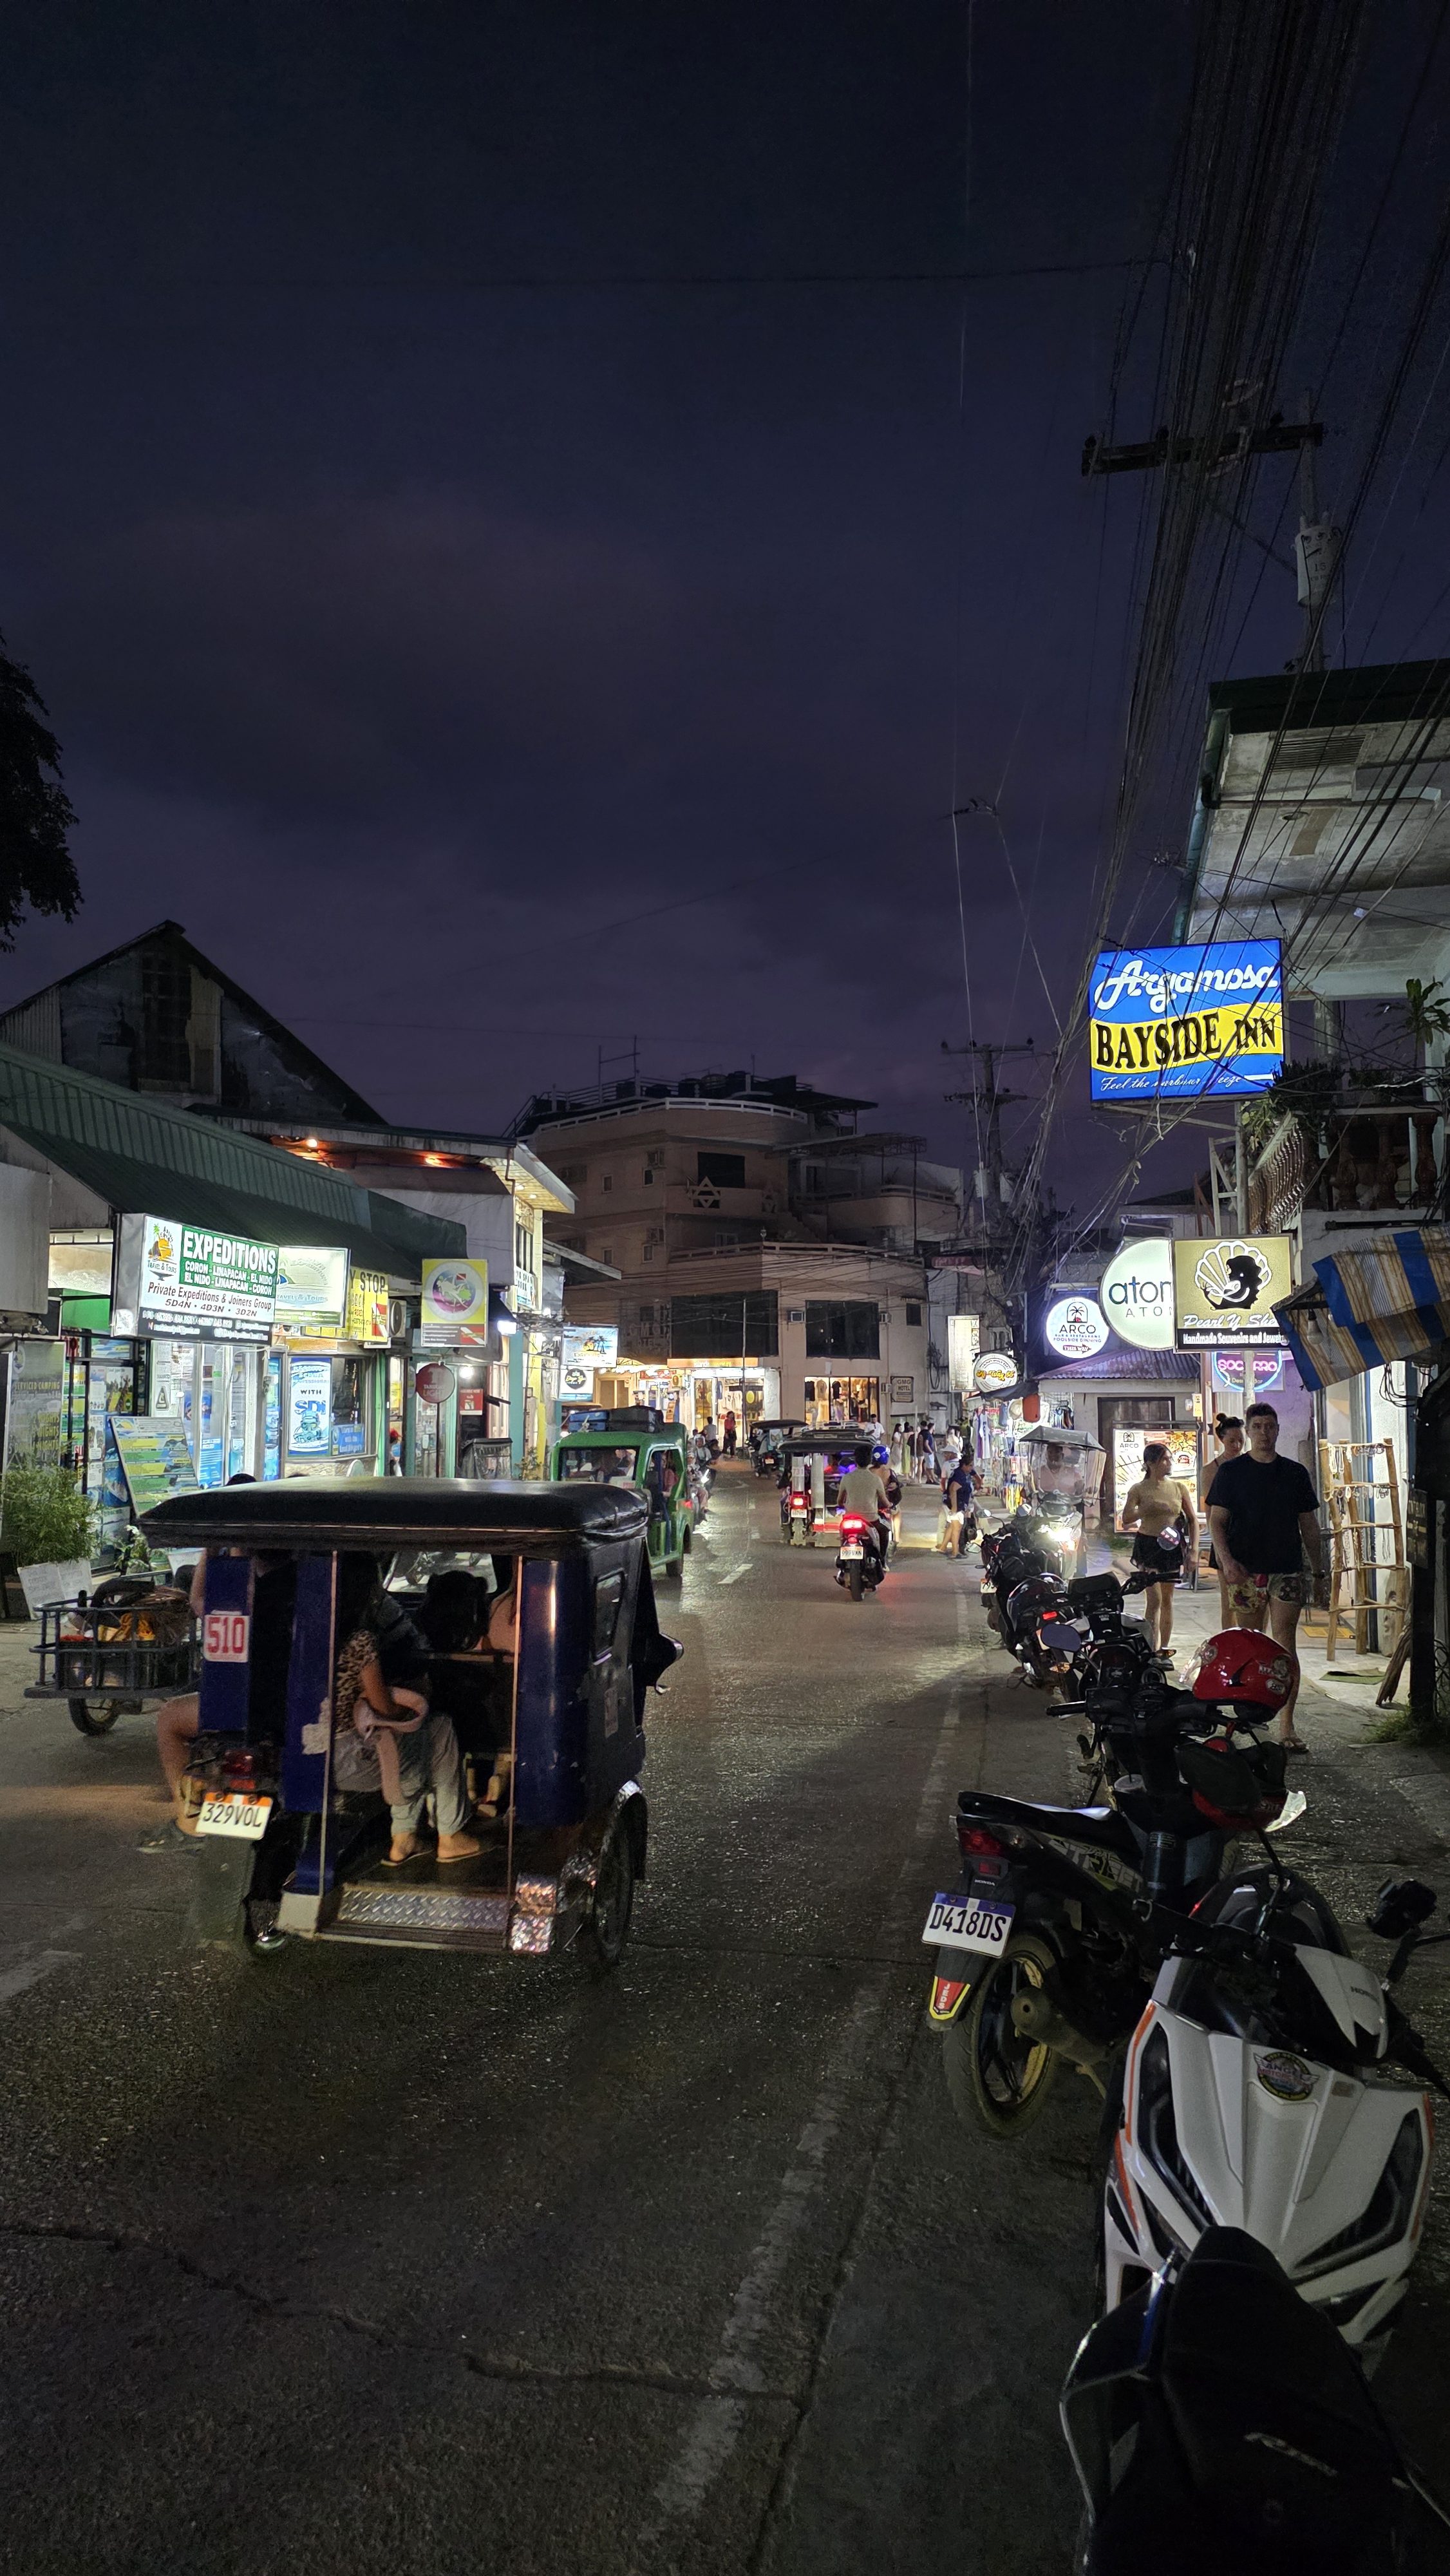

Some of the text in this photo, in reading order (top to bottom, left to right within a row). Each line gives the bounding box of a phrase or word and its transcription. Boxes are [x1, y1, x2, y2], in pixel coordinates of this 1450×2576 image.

[1094, 960, 1279, 1013] Argamosa
[1096, 1012, 1276, 1069] BAYSIDE INN
[1100, 1077, 1129, 1091] Feel
[1129, 1076, 1149, 1088] the
[183, 1230, 277, 1274] EXPEDITIONS
[184, 1271, 193, 1283] EL
[194, 1274, 211, 1286] NIDO
[252, 1283, 272, 1296] CORON
[185, 1260, 209, 1274] CORON
[212, 1265, 247, 1281] LINAPACAN
[250, 1273, 258, 1283] EL
[259, 1274, 273, 1285] NIDO
[360, 1271, 386, 1295] STOP
[147, 1282, 272, 1312] Private Expeditions & Joiners Group
[165, 1298, 258, 1317] 5D4N 4D3N 3D2N
[1059, 1325, 1096, 1334] ARCO
[1183, 1314, 1225, 1328] Pearl
[1227, 1313, 1242, 1331] Y
[1183, 1332, 1217, 1344] Handmade
[1218, 1332, 1249, 1344] Souvenirs
[1249, 1331, 1262, 1344] and
[1218, 1359, 1278, 1371] SOCRRO
[207, 1616, 245, 1654] 510
[202, 1803, 263, 1828] 329VOL
[974, 1879, 995, 1887] HONDA
[928, 1904, 1006, 1942] D418DS
[937, 1983, 950, 2010] JEDS
